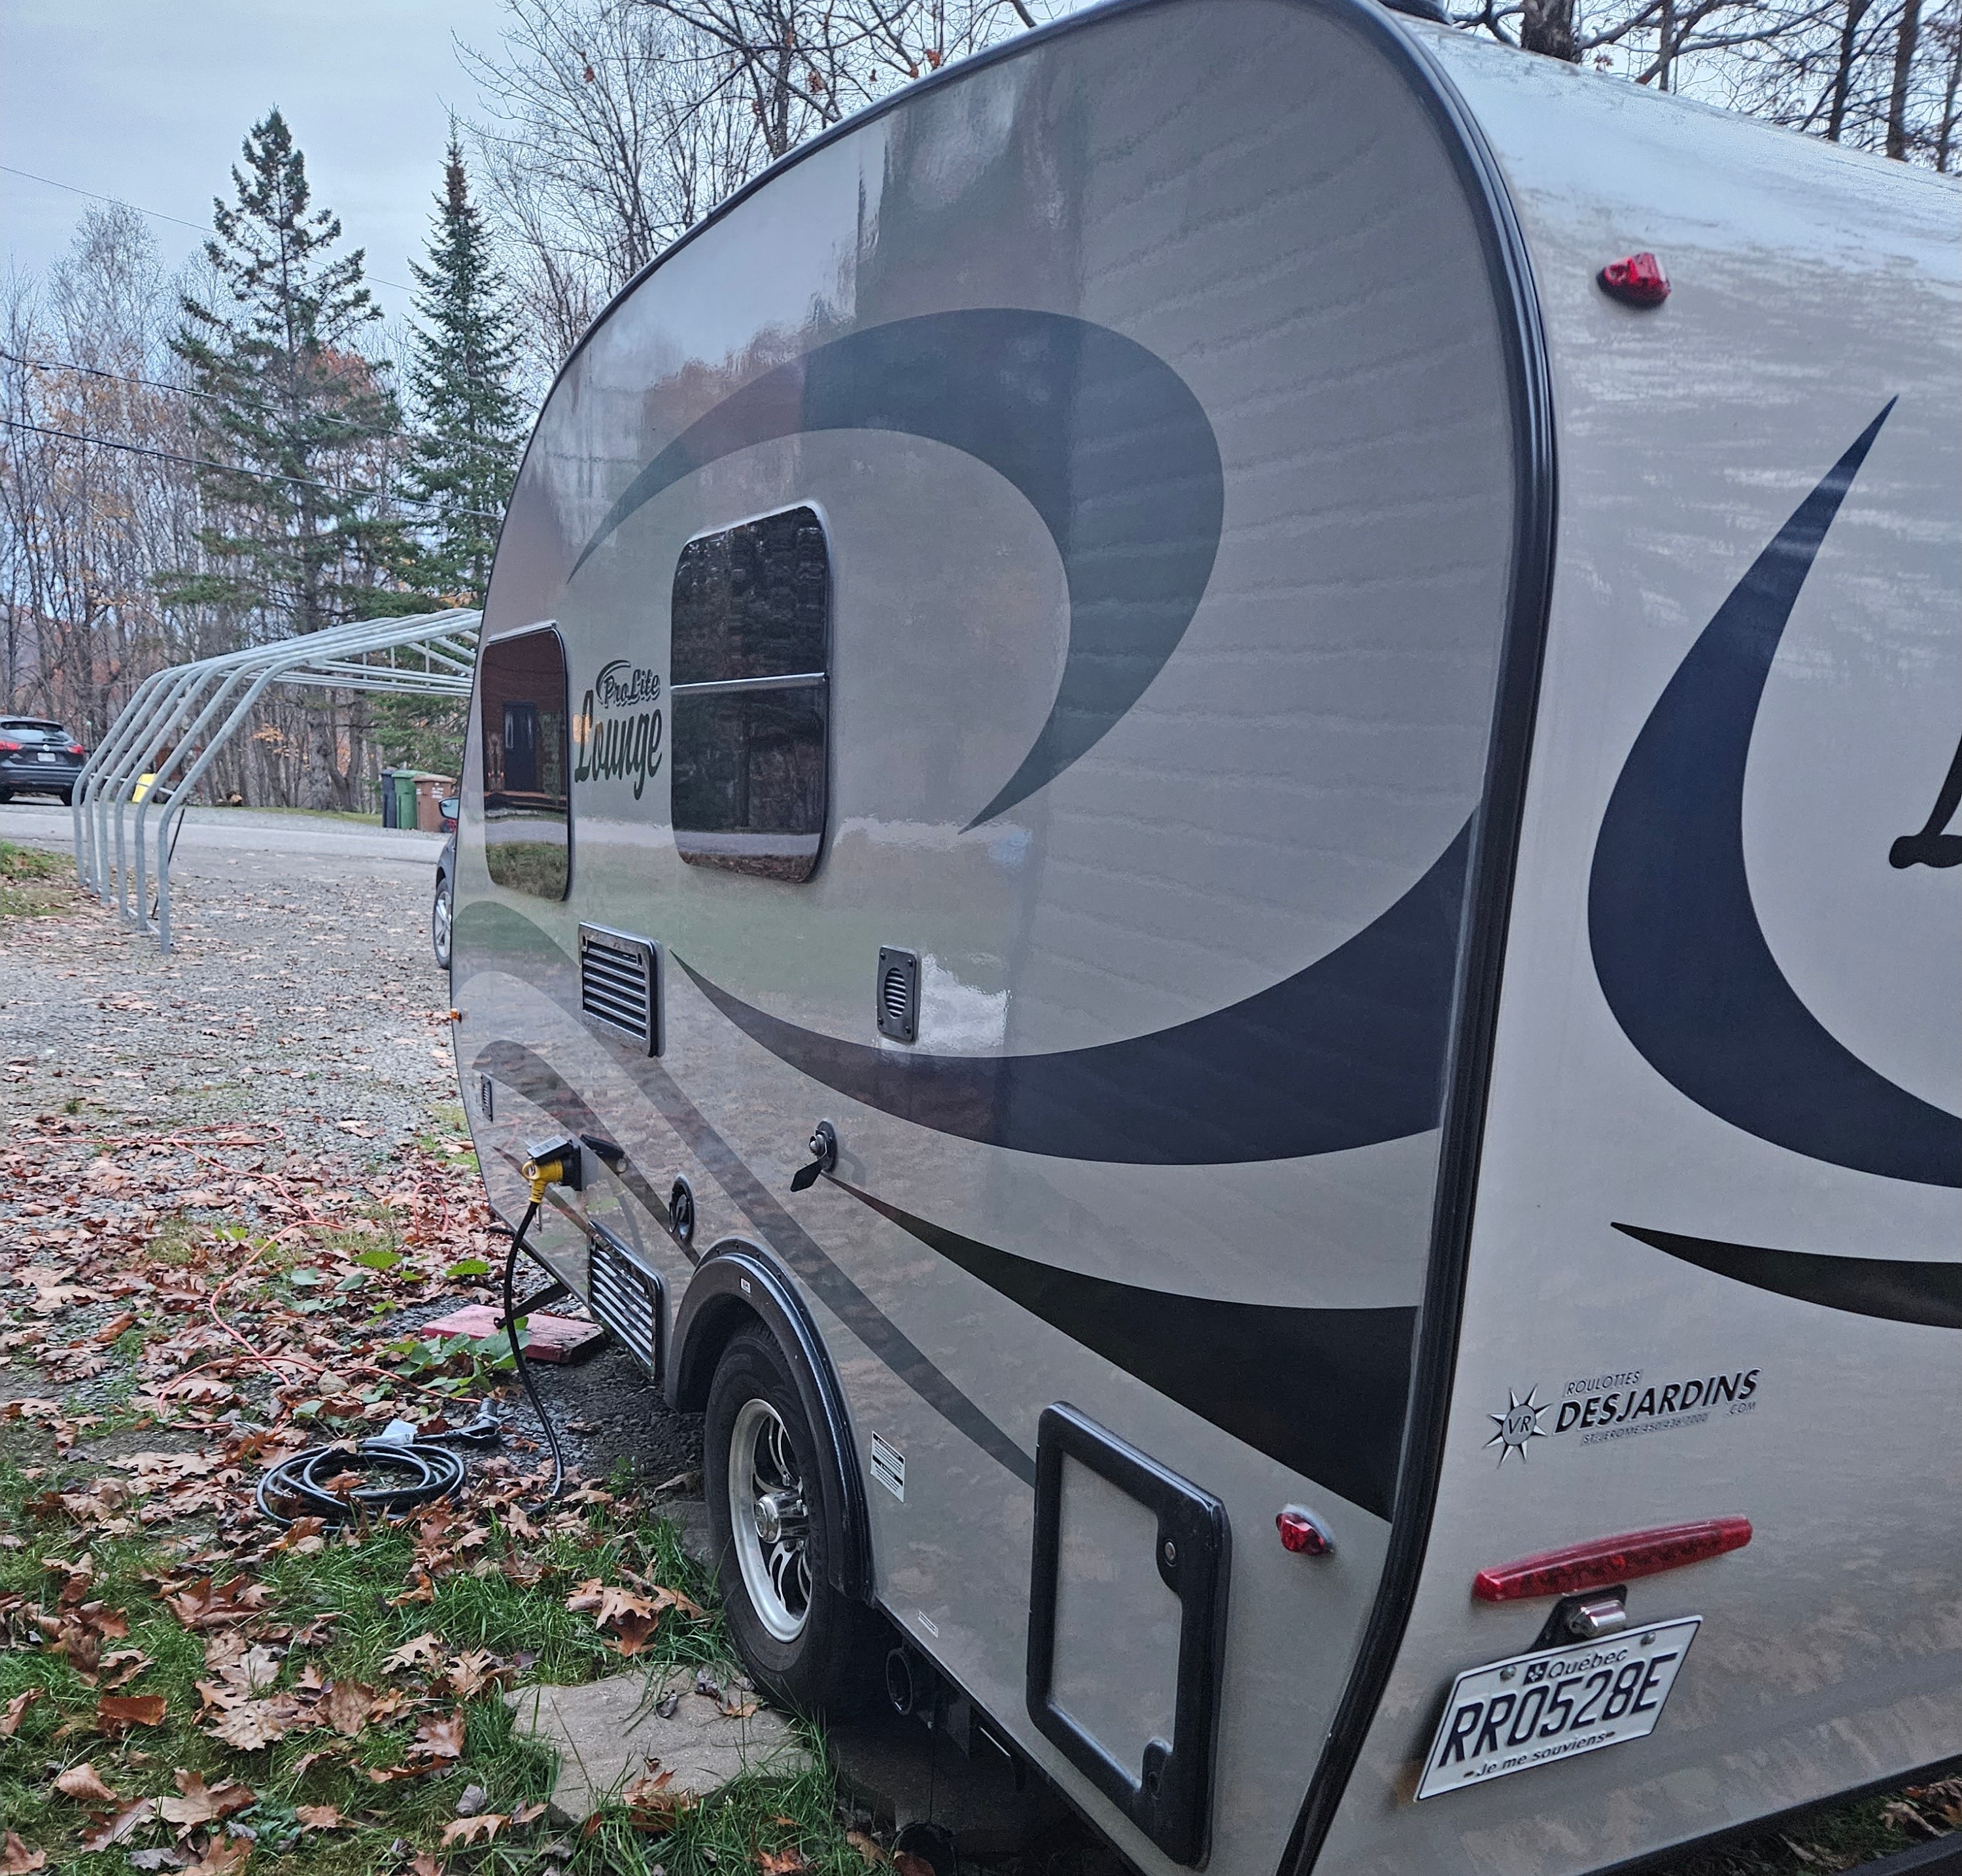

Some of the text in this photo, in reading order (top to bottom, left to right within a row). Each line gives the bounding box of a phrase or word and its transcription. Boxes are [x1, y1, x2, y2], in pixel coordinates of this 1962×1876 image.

[604, 669, 661, 709] ProLite
[574, 689, 662, 801] Lounge
[1554, 1368, 1762, 1434] DESJARDINS
[1566, 1371, 1640, 1395] ROULOTTES
[1508, 1415, 1532, 1434] VR
[1548, 1649, 1628, 1678] Québec
[1437, 1652, 1678, 1768] RR0528E
[1475, 1732, 1606, 1777] Je me souviens
